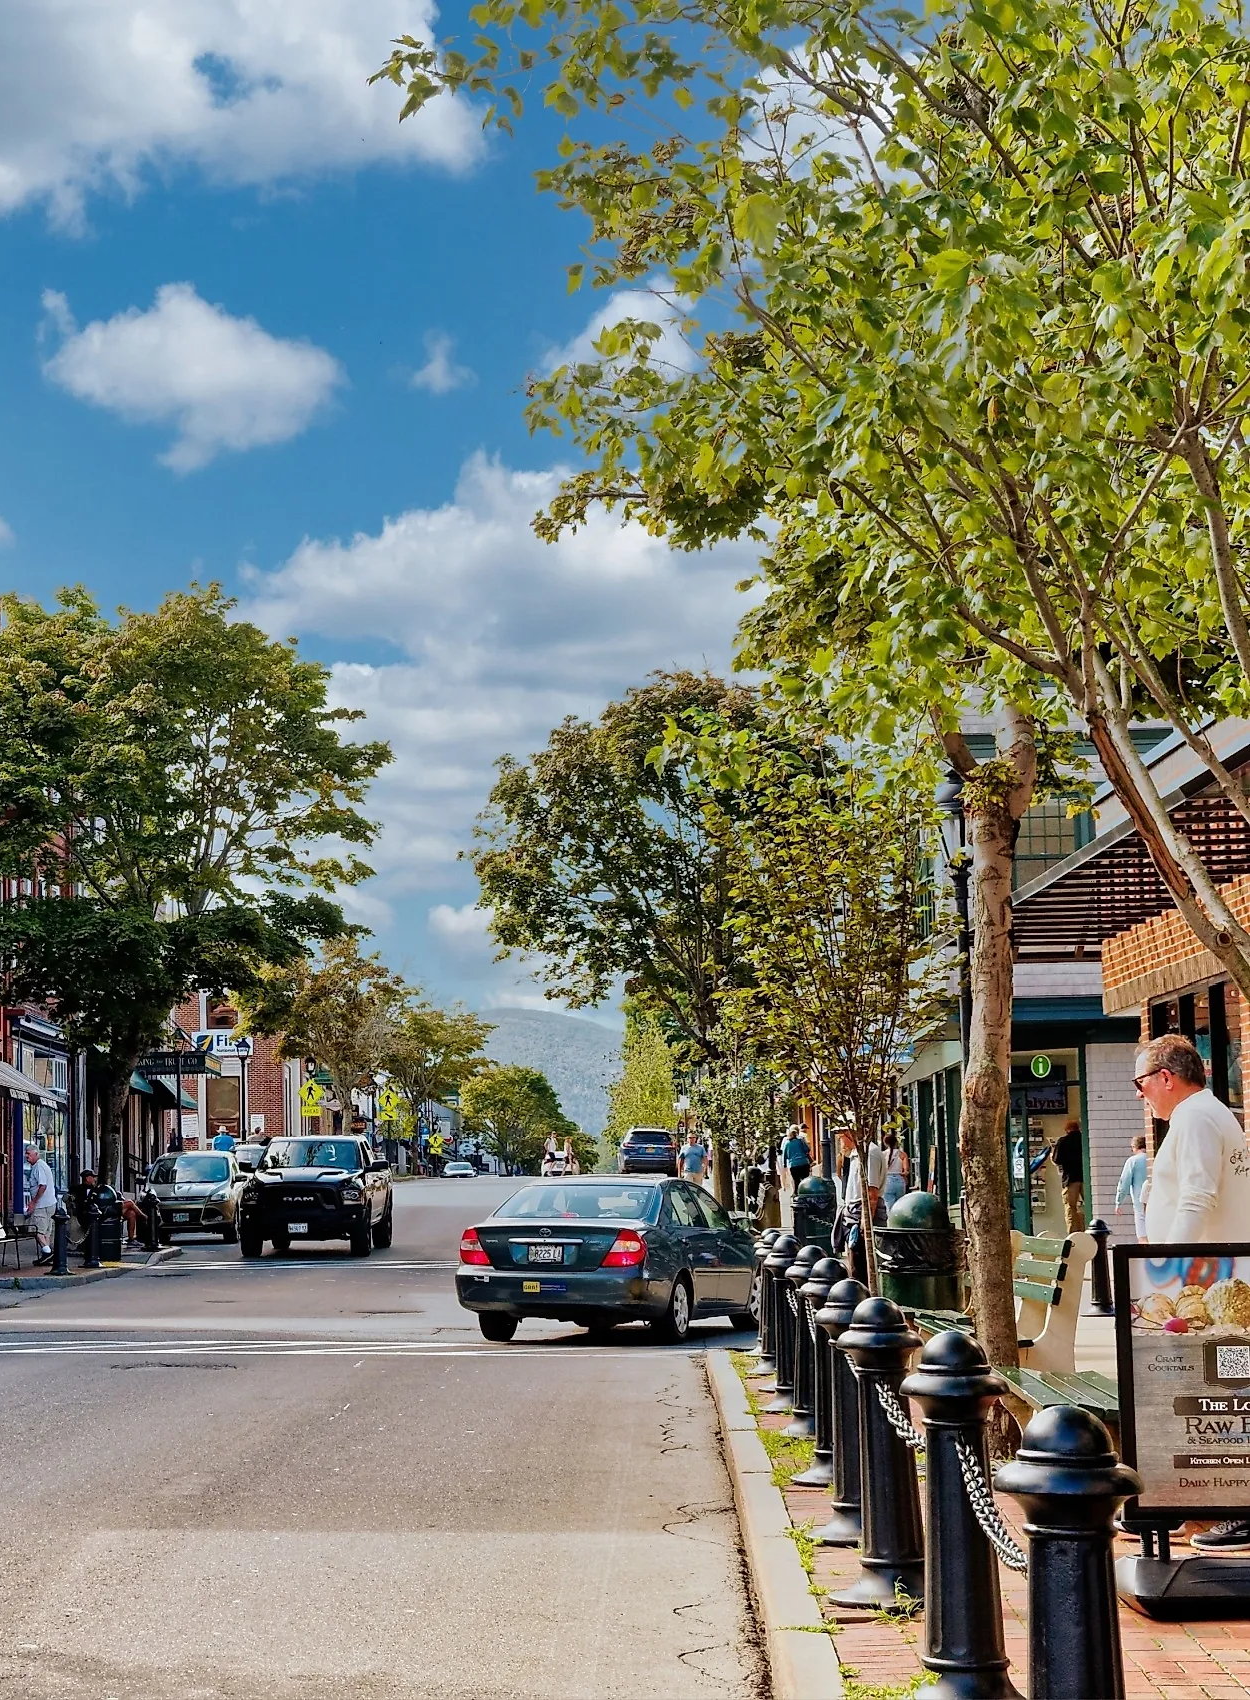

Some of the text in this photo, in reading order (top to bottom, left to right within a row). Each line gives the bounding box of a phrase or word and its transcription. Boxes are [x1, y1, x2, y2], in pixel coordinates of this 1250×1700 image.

[1148, 1364, 1194, 1372] COCKTAILS
[1198, 1398, 1228, 1411] THE
[1185, 1416, 1234, 1435] RAW
[1187, 1436, 1196, 1444] &
[1199, 1436, 1243, 1444] SEAFOOD
[1190, 1457, 1221, 1465] KITCHEN
[1223, 1456, 1244, 1464] OPEN
[1179, 1477, 1250, 1487] DAILY HAPPY
